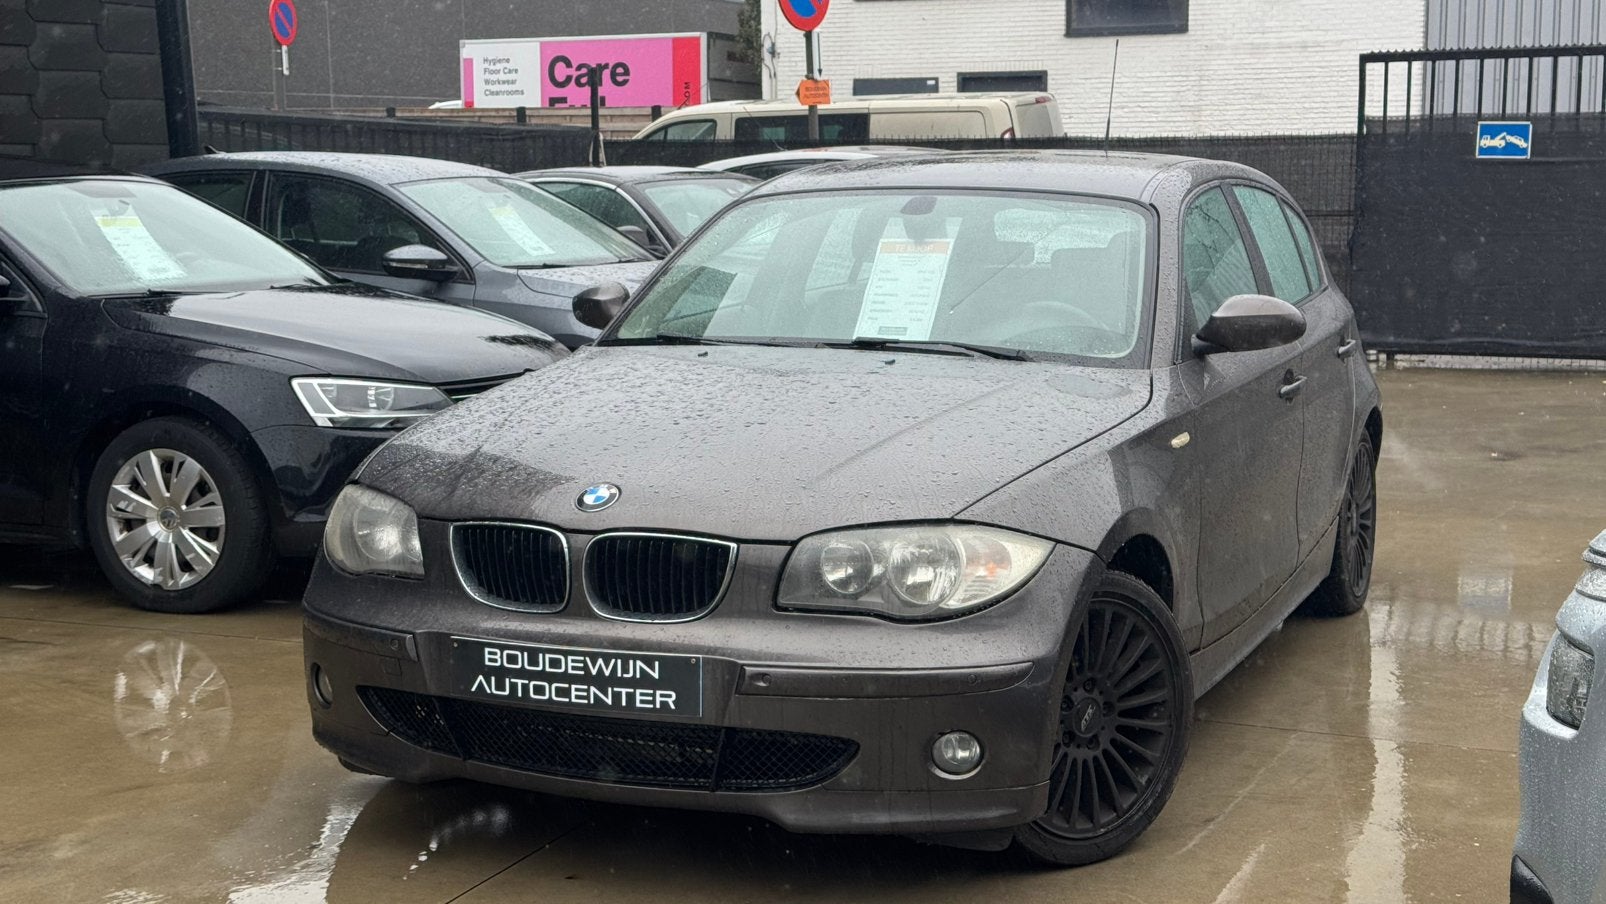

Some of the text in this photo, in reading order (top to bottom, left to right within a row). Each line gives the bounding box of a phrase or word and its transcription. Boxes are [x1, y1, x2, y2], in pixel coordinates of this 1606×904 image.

[482, 56, 511, 66] Hygiene
[483, 66, 519, 75] Floor Care
[548, 55, 631, 89] Care
[483, 78, 517, 86] Workwear
[483, 88, 525, 97] Cleanrooms
[484, 647, 659, 680] BOUDEWIJN
[470, 674, 677, 710] AUTOCENTER
